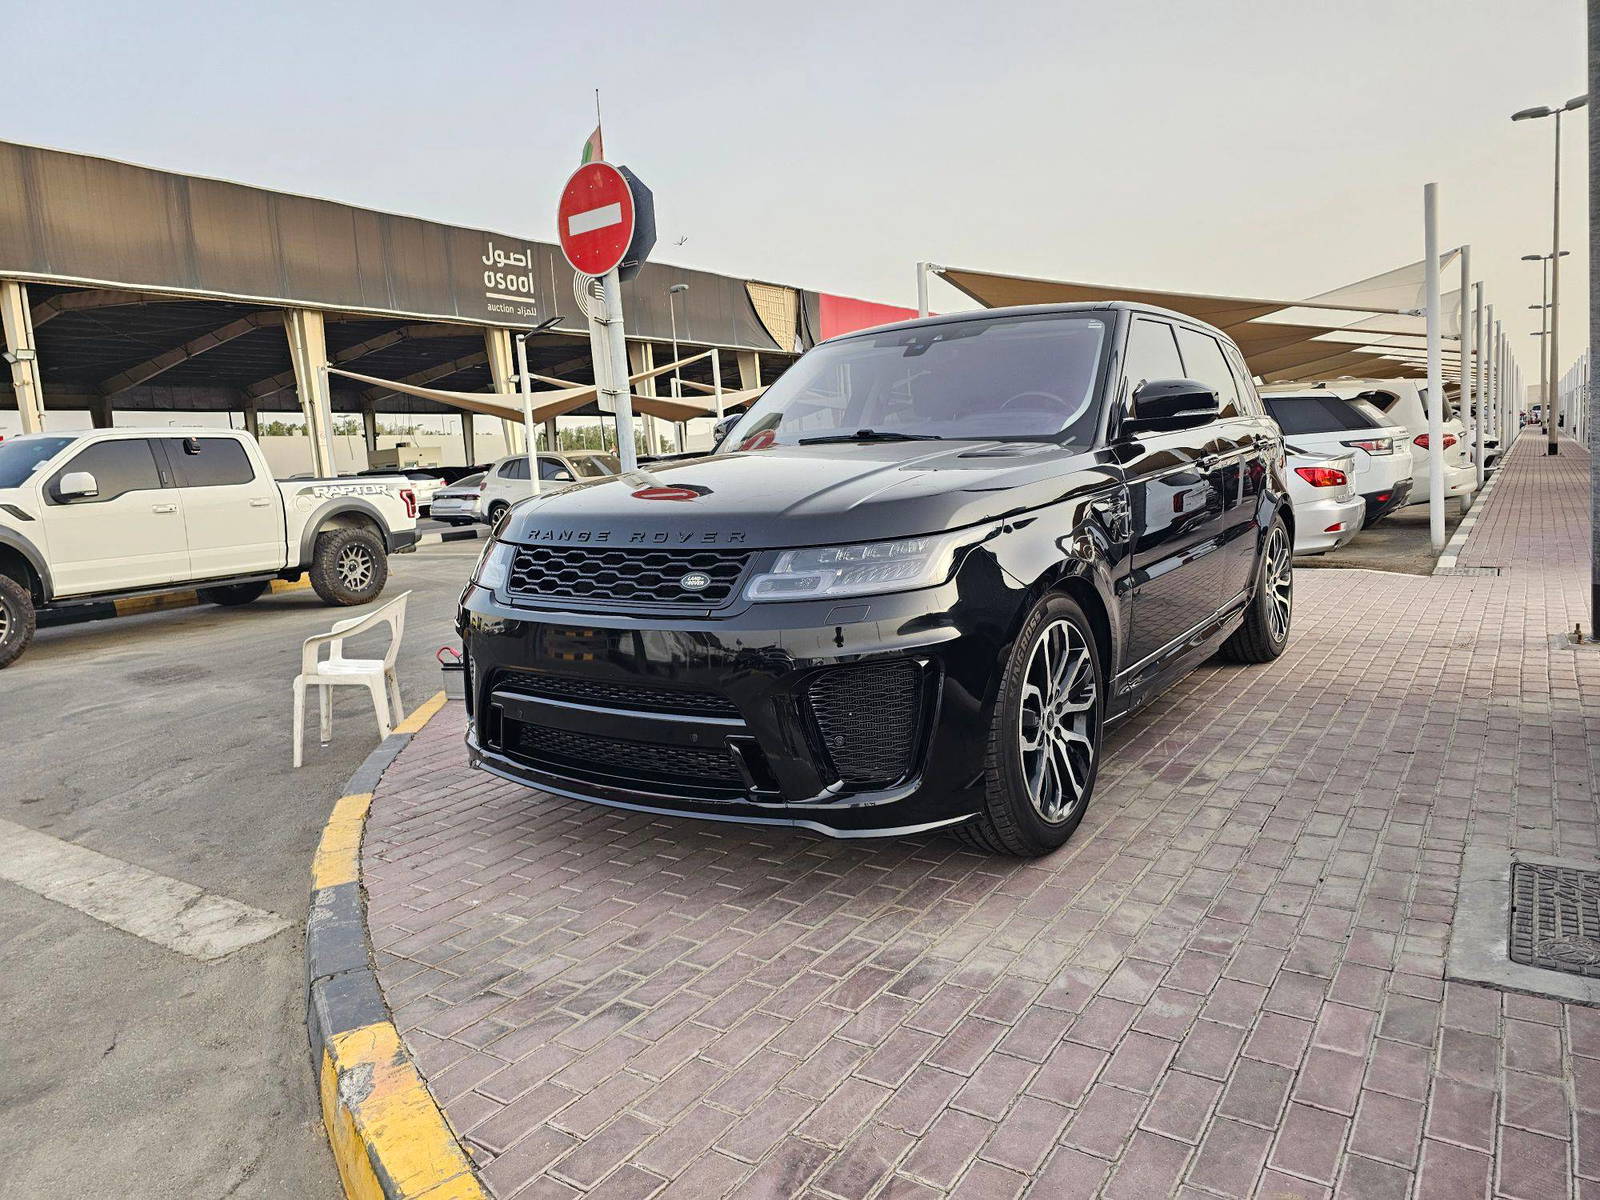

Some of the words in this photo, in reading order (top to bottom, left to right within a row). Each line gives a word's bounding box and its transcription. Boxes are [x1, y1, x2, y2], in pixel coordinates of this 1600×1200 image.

[487, 303, 514, 314] auction
[313, 484, 394, 499] RAPTOR
[528, 529, 610, 542] RANGE
[629, 531, 746, 544] ROVER
